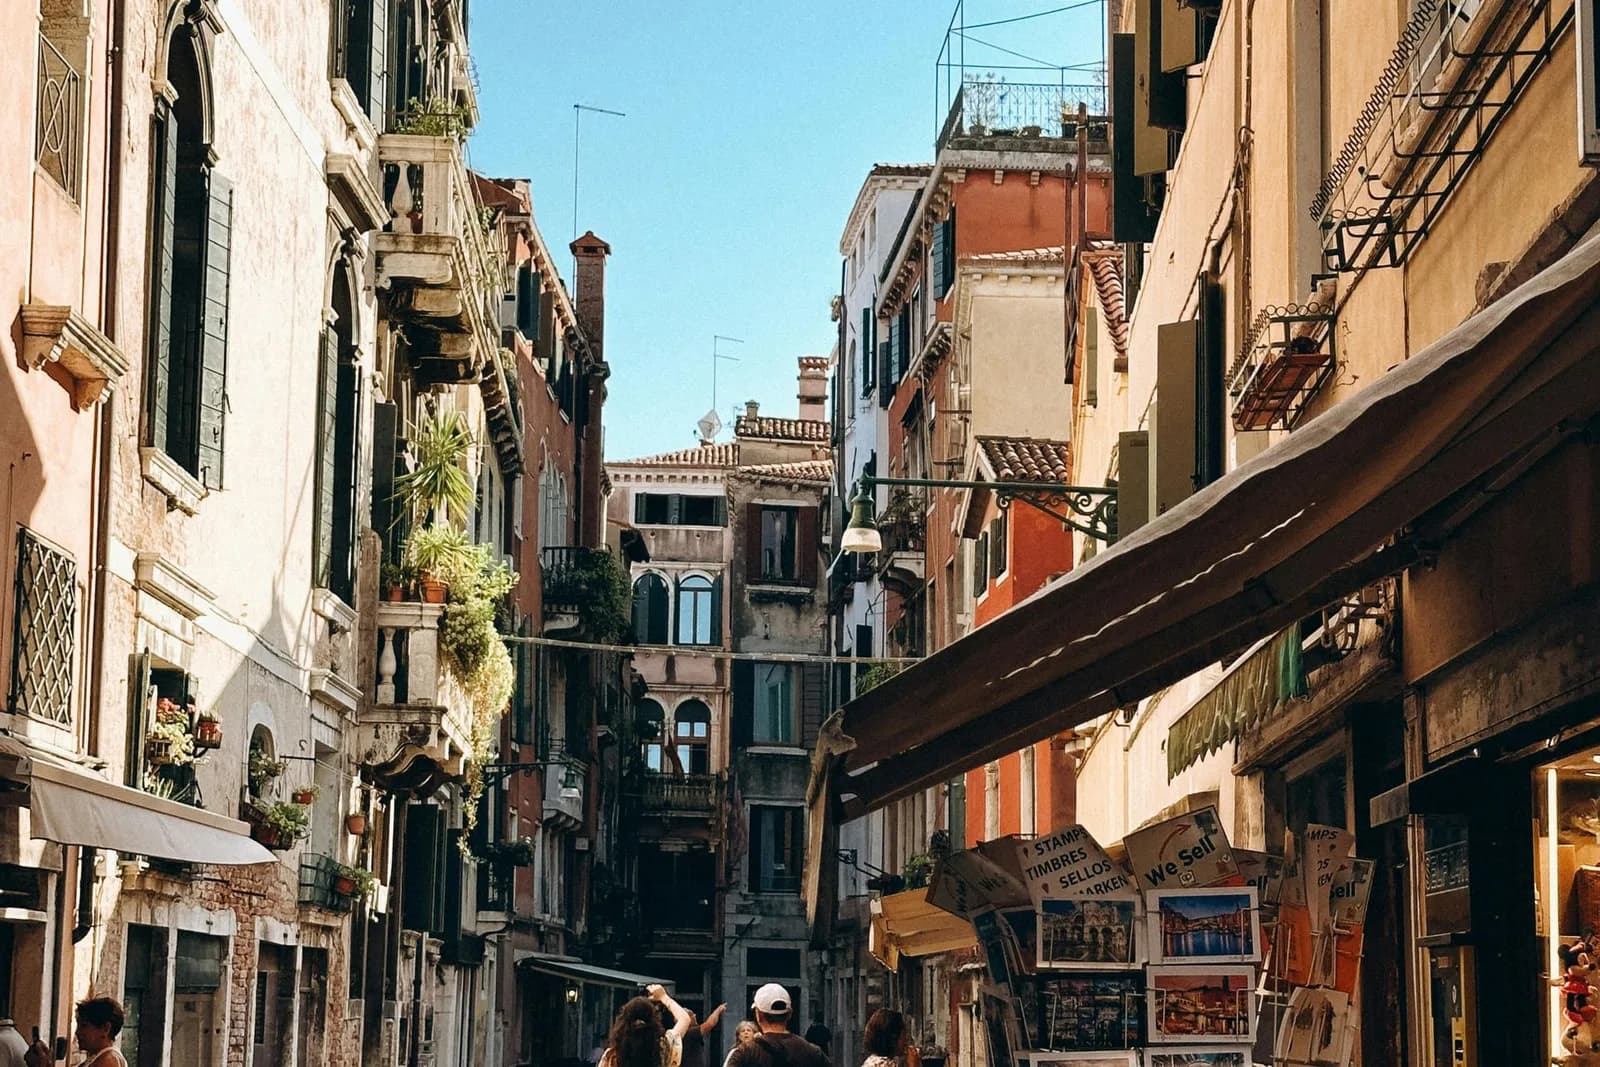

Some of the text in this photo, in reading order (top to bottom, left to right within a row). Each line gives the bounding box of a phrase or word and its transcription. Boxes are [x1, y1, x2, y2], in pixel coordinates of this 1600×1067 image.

[1035, 828, 1088, 856] STAMPS
[1025, 848, 1088, 881] TIMBRES
[1059, 860, 1112, 889] SELLOS
[1145, 836, 1216, 887] We Sell
